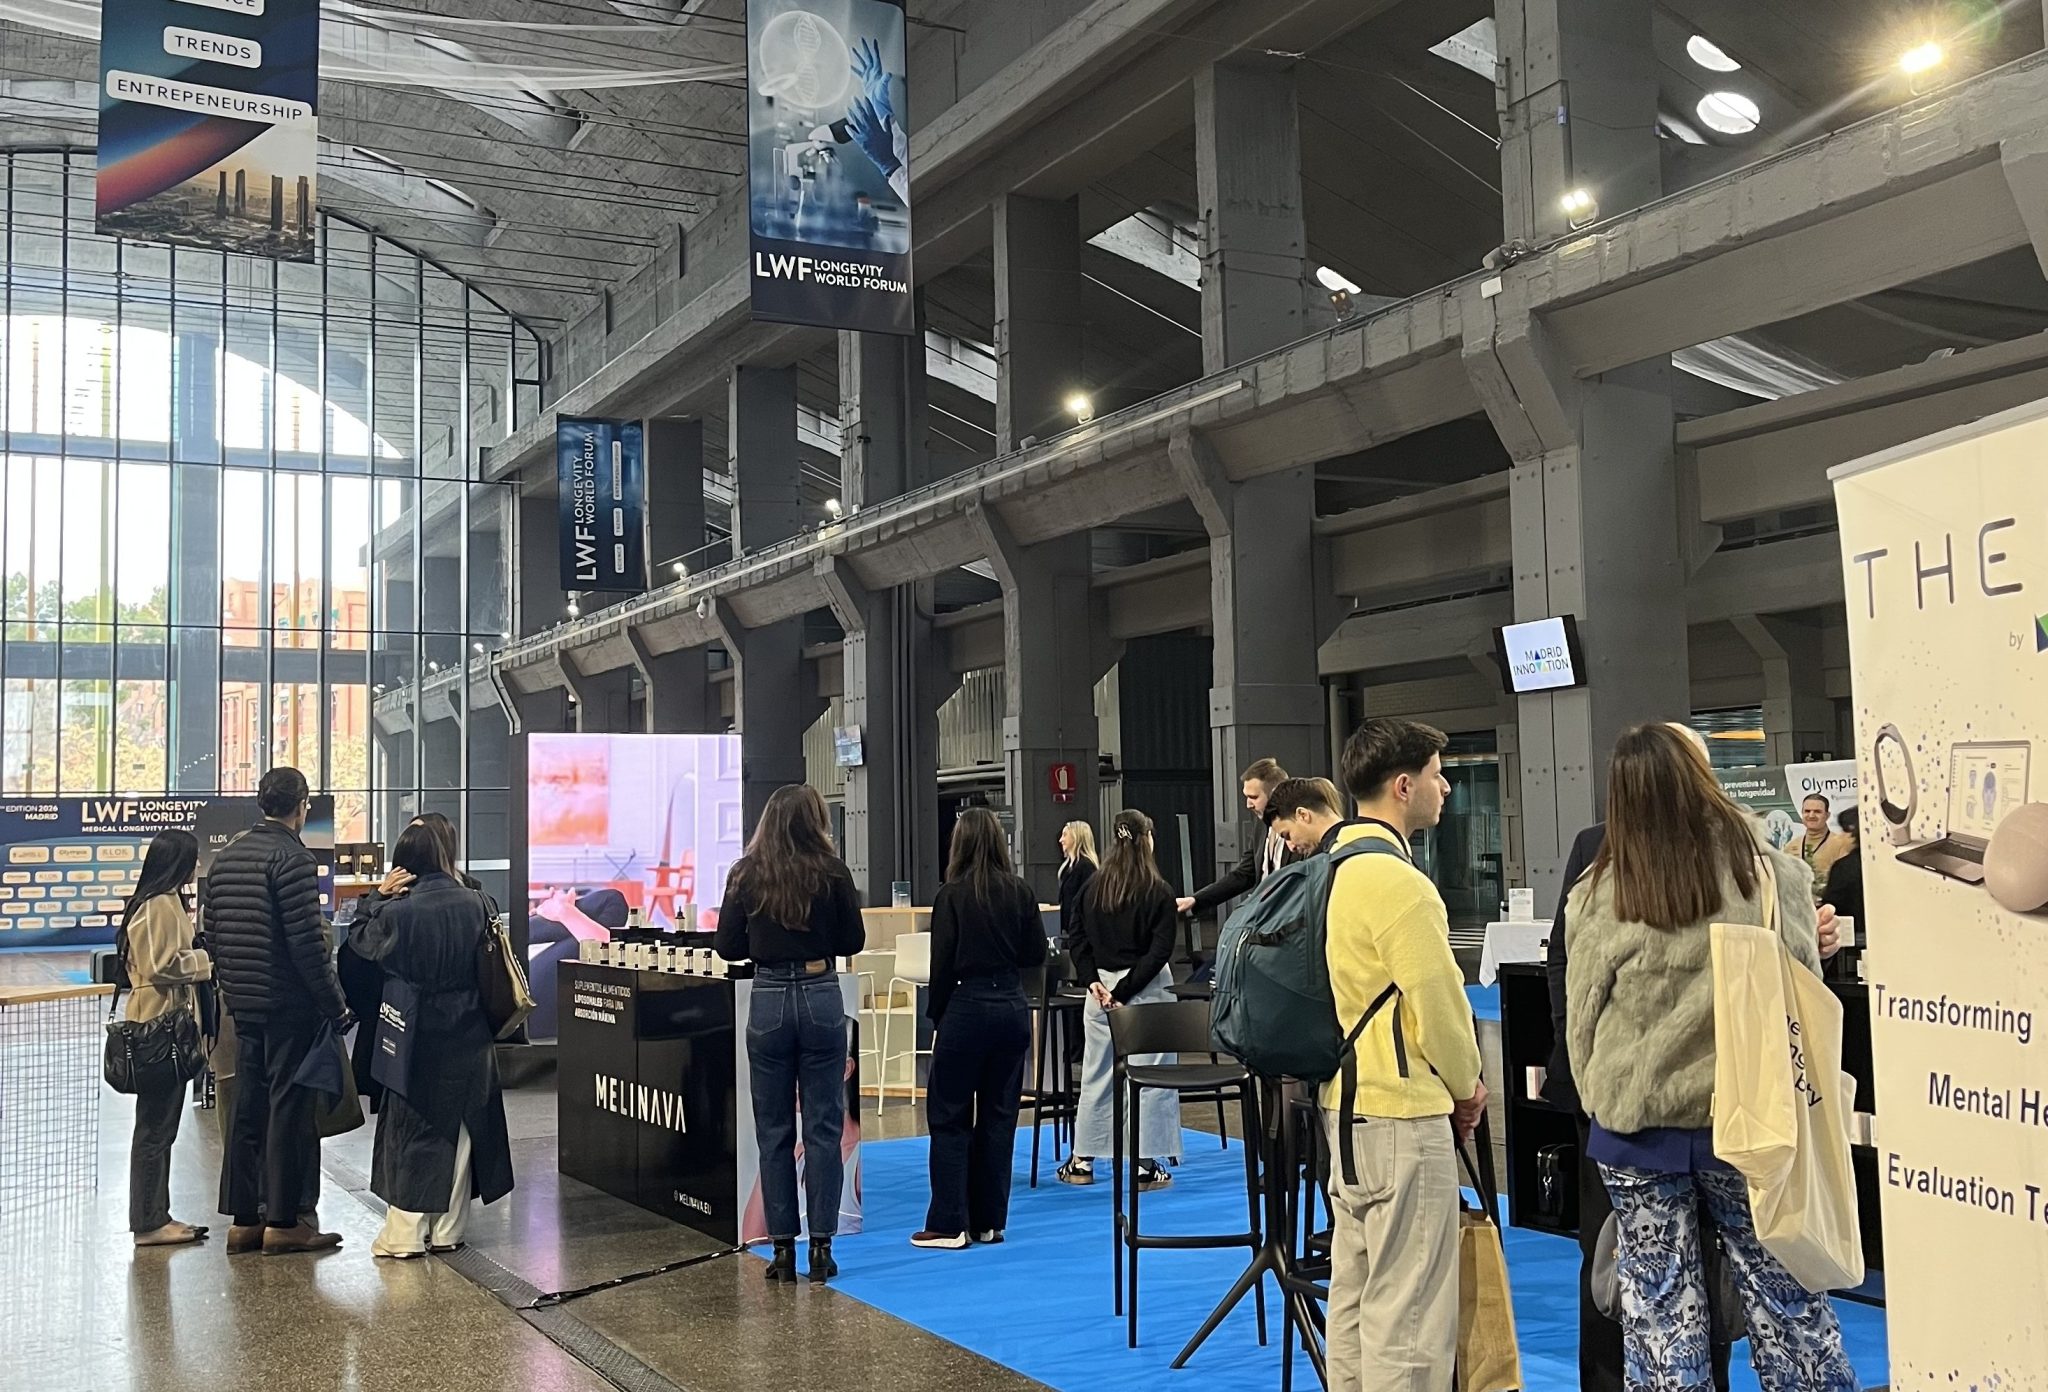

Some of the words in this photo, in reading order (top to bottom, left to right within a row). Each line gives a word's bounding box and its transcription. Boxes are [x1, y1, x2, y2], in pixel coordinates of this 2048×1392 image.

[175, 35, 251, 59] TRENDS
[118, 79, 302, 120] ENTREPENEURSHIP
[756, 252, 813, 281] LWF
[814, 259, 883, 277] LONGEVITY
[814, 272, 861, 287] WORLD
[863, 278, 908, 293] FORUM
[584, 432, 595, 477] FORUM
[573, 455, 584, 523] LONGEVITY
[585, 481, 595, 525] WORLD
[575, 525, 597, 580] LWF
[1854, 517, 2024, 619] THE
[2009, 631, 2024, 651] by
[1525, 646, 1562, 661] MADRID
[1513, 658, 1569, 676] INNOVATION
[1724, 779, 1759, 790] preventiva
[1760, 779, 1767, 787] al
[1738, 788, 1776, 799] longevidad
[6, 804, 38, 812] EDITION
[39, 804, 58, 812] 2026
[82, 801, 138, 823] LWF
[140, 801, 208, 811] LONGEVITY
[140, 812, 185, 822] WORLD
[1876, 984, 2032, 1044] Transforming
[595, 1073, 686, 1134] MELINAVA
[1929, 1072, 2011, 1120] Mental
[1888, 1152, 2015, 1216] Evaluation
